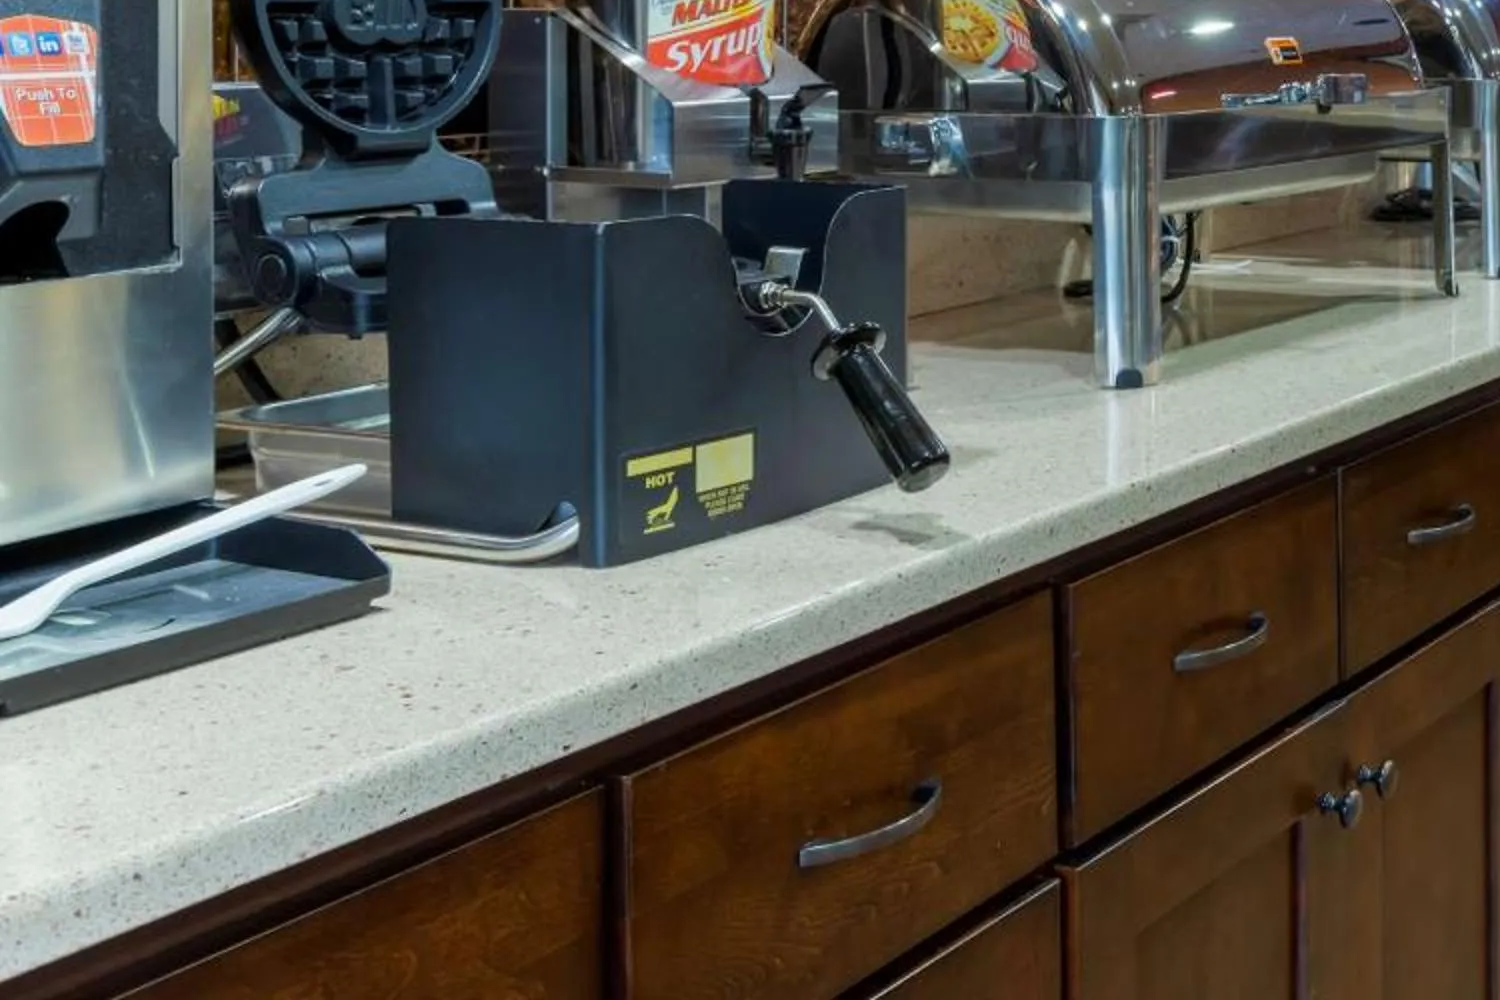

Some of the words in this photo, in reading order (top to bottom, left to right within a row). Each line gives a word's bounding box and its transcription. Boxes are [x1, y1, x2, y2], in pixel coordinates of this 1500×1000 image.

[664, 23, 763, 73] Syrup
[16, 87, 54, 101] Push
[56, 87, 77, 100] To
[40, 102, 60, 115] Fill
[645, 472, 676, 488] HOT
